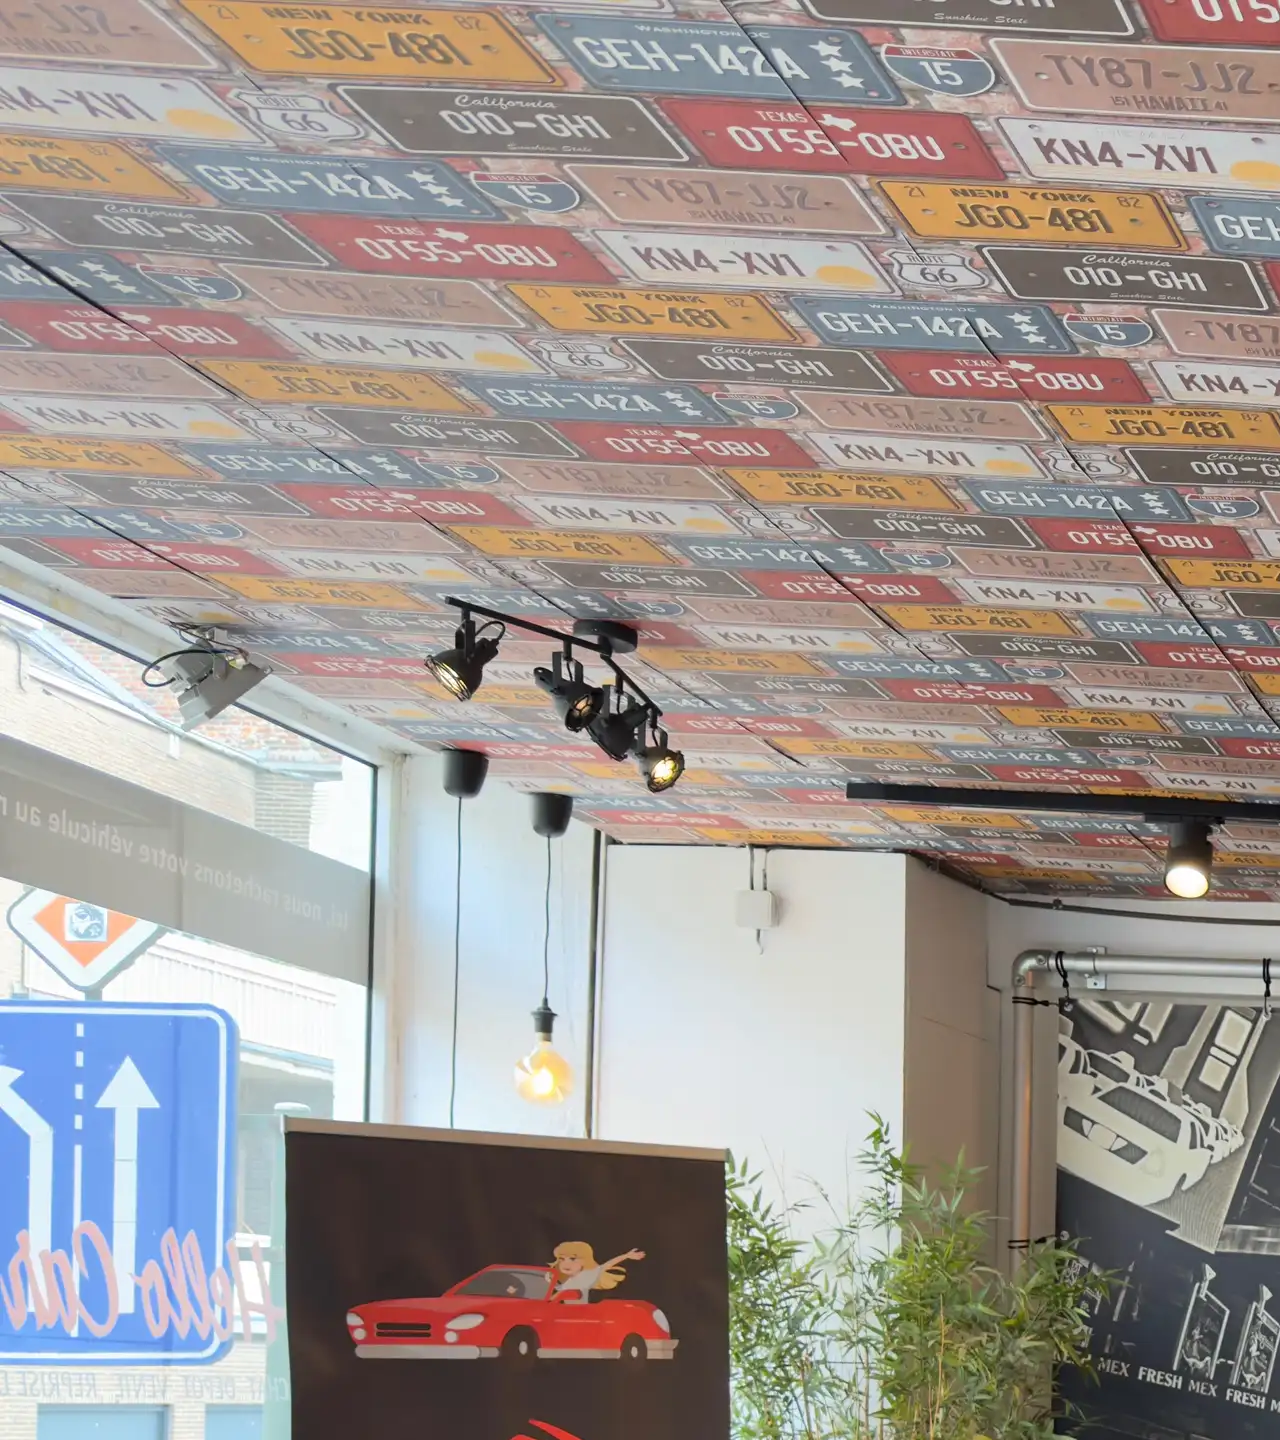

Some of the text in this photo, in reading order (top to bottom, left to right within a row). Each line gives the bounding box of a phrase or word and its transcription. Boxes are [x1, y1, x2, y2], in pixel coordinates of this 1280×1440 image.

[257, 5, 434, 25] NEW YORK
[567, 36, 812, 79] GEH-142A
[917, 60, 967, 86] 15
[1043, 54, 1264, 96] TY87-JJ2
[446, 94, 561, 112] California
[752, 109, 809, 122] TEXAS
[271, 111, 333, 132] 66
[189, 166, 418, 200] GEH-142A
[1097, 1357, 1130, 1378] MEX
[1137, 1366, 1183, 1389] FRESH
[1188, 1379, 1219, 1398] MEX
[1226, 1388, 1267, 1410] FRESH
